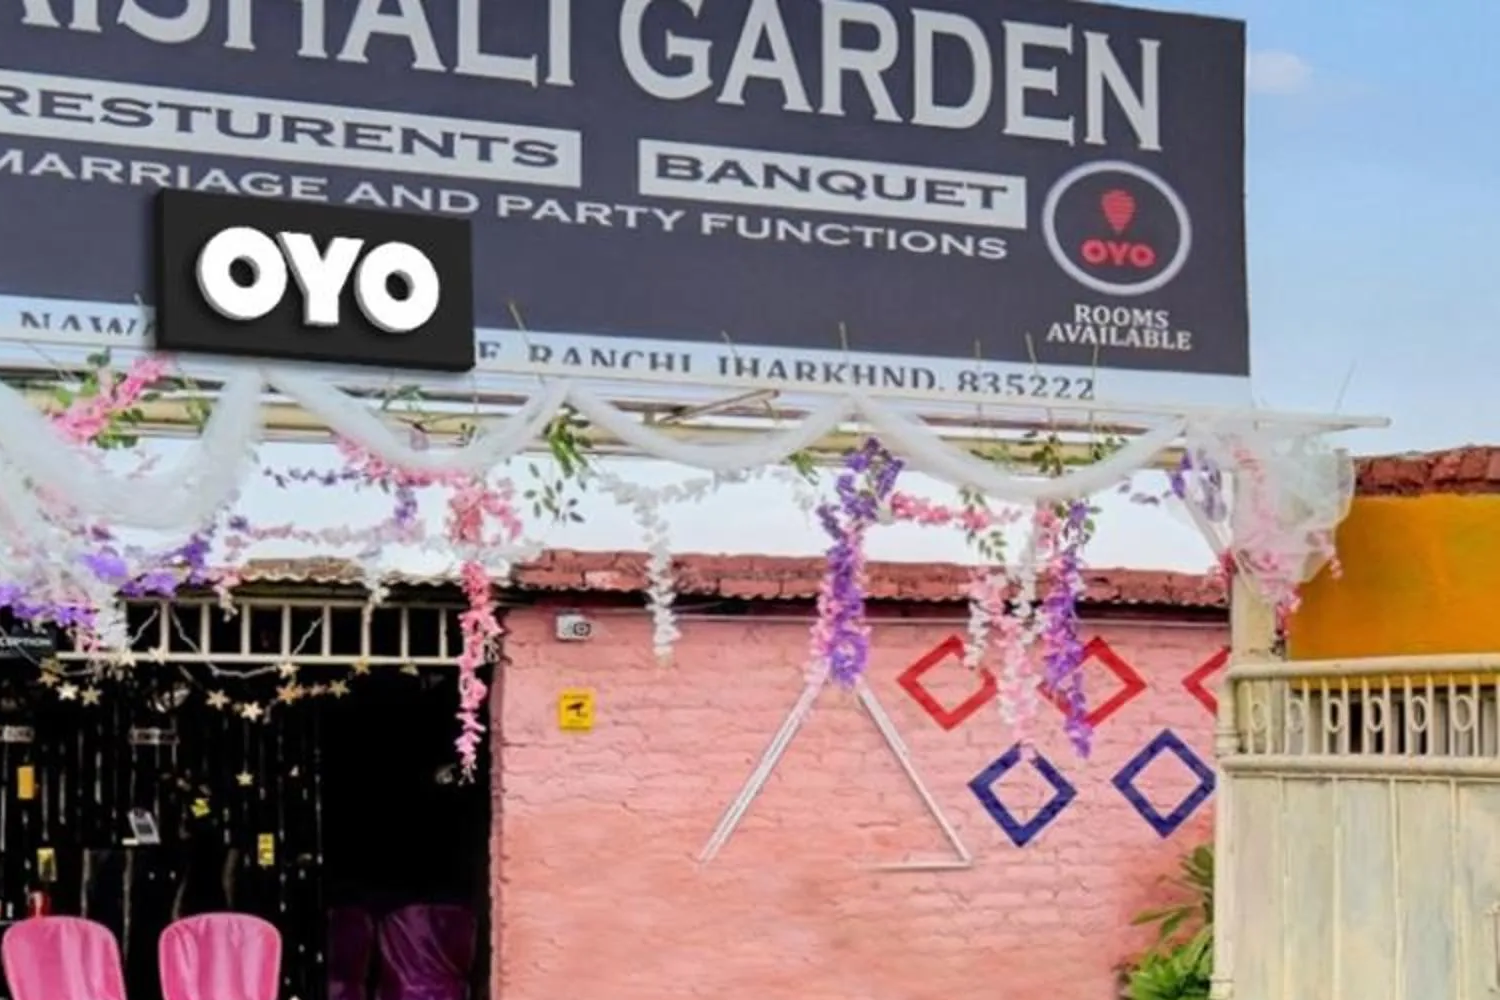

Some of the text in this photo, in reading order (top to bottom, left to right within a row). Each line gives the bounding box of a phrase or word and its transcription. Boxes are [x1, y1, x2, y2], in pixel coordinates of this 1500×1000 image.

[619, 0, 1162, 151] GARDEN
[655, 152, 1008, 211] BANQUET
[345, 181, 480, 214] AND
[497, 195, 684, 233] PARTY
[700, 212, 1008, 260] FUNCTIONS
[1080, 238, 1156, 268] OYO
[196, 226, 440, 333] OYO
[1046, 321, 1192, 352] AVAILABLE
[1073, 304, 1170, 331] ROOMS
[957, 369, 1095, 401] 835222
